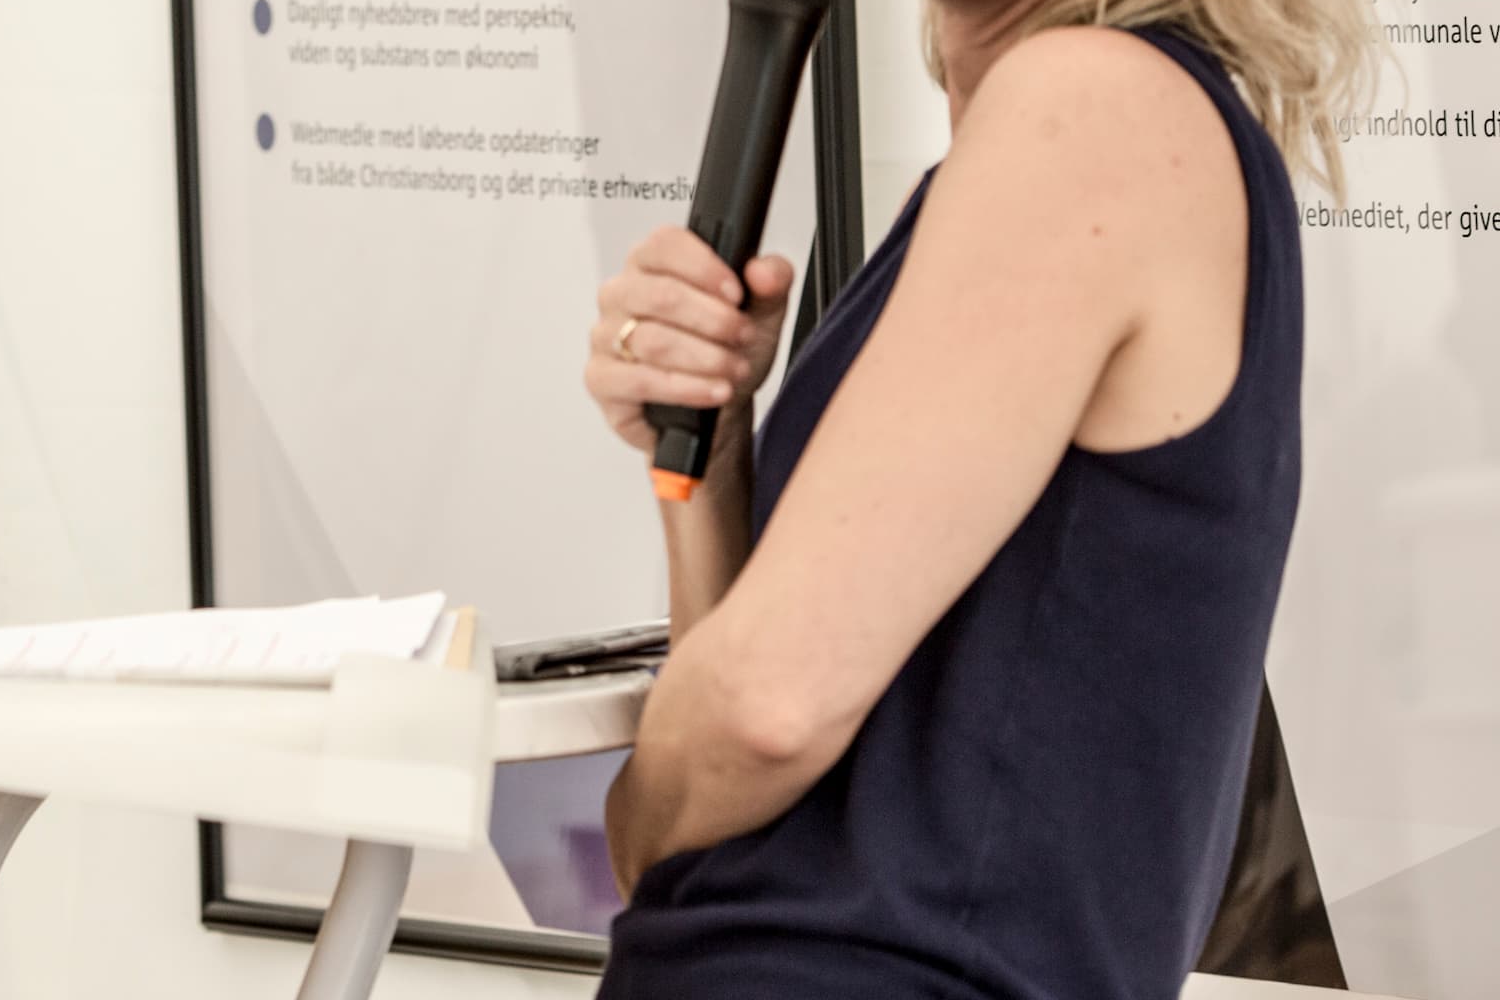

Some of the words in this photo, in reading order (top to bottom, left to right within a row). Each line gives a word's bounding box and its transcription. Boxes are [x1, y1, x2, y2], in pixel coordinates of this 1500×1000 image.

[287, 0, 344, 36] Dagligt
[348, 0, 440, 36] nyhedsbrev
[444, 1, 481, 30] med
[485, 2, 576, 35] perspektiv,
[288, 40, 331, 66] viden
[336, 47, 357, 72] og
[361, 42, 430, 69] substans
[433, 49, 461, 69] om
[465, 44, 539, 71] økonomi
[1367, 110, 1447, 137] indhold
[1454, 110, 1477, 138] til
[290, 121, 376, 150] Webmedie
[379, 123, 415, 152] med
[418, 125, 486, 154] løbende
[490, 130, 600, 162] opdateringer
[291, 161, 314, 187] fra
[316, 163, 356, 189] både
[360, 164, 476, 198] Christiansborg
[480, 174, 502, 200] og
[506, 170, 536, 198] det
[539, 171, 598, 200] private
[1418, 202, 1452, 231] der
